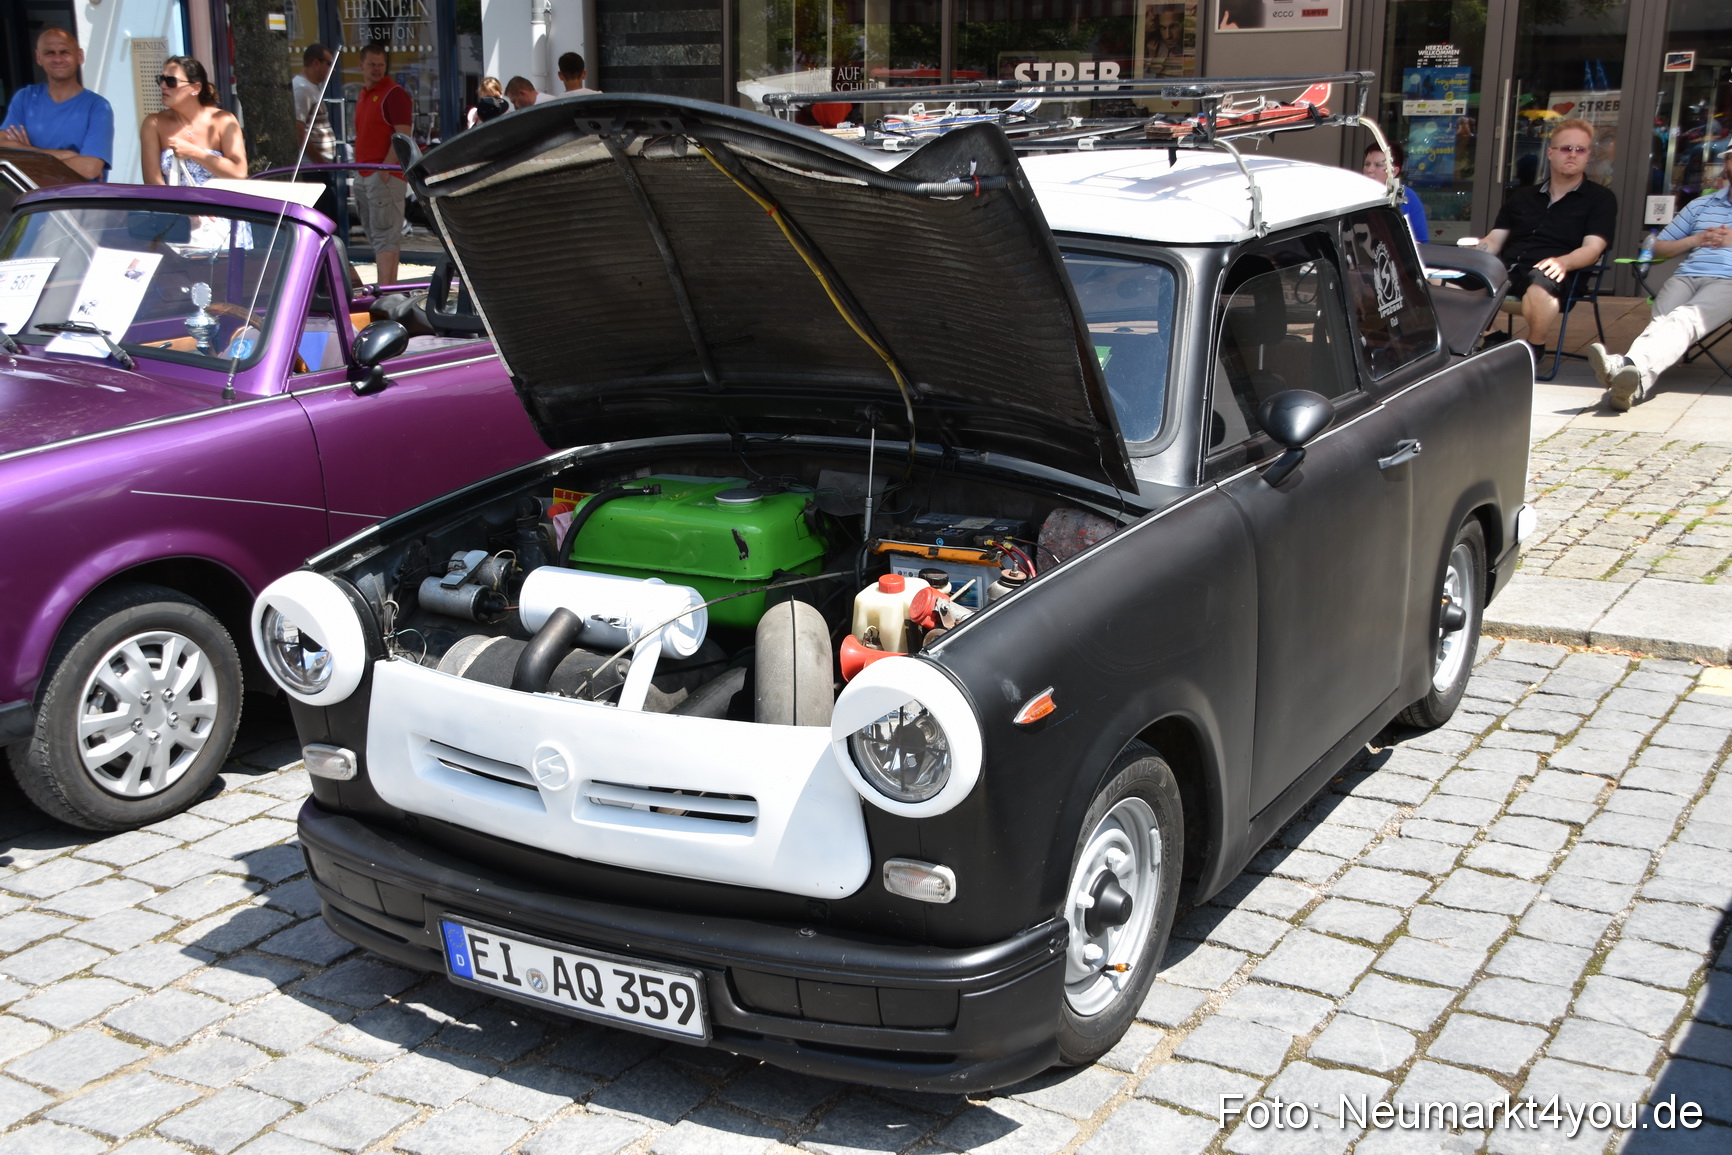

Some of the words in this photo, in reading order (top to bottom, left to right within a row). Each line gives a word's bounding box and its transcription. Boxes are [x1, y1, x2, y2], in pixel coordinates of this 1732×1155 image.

[344, 0, 430, 19] HEINLEIN
[359, 27, 415, 40] FASHION
[837, 67, 860, 81] AUF
[1014, 61, 1120, 92] STREB
[1577, 100, 1620, 112] STREB
[10, 274, 36, 290] 587
[456, 953, 465, 967] D
[467, 933, 522, 987] EI
[553, 955, 606, 1008] AQ
[612, 968, 696, 1026] 359
